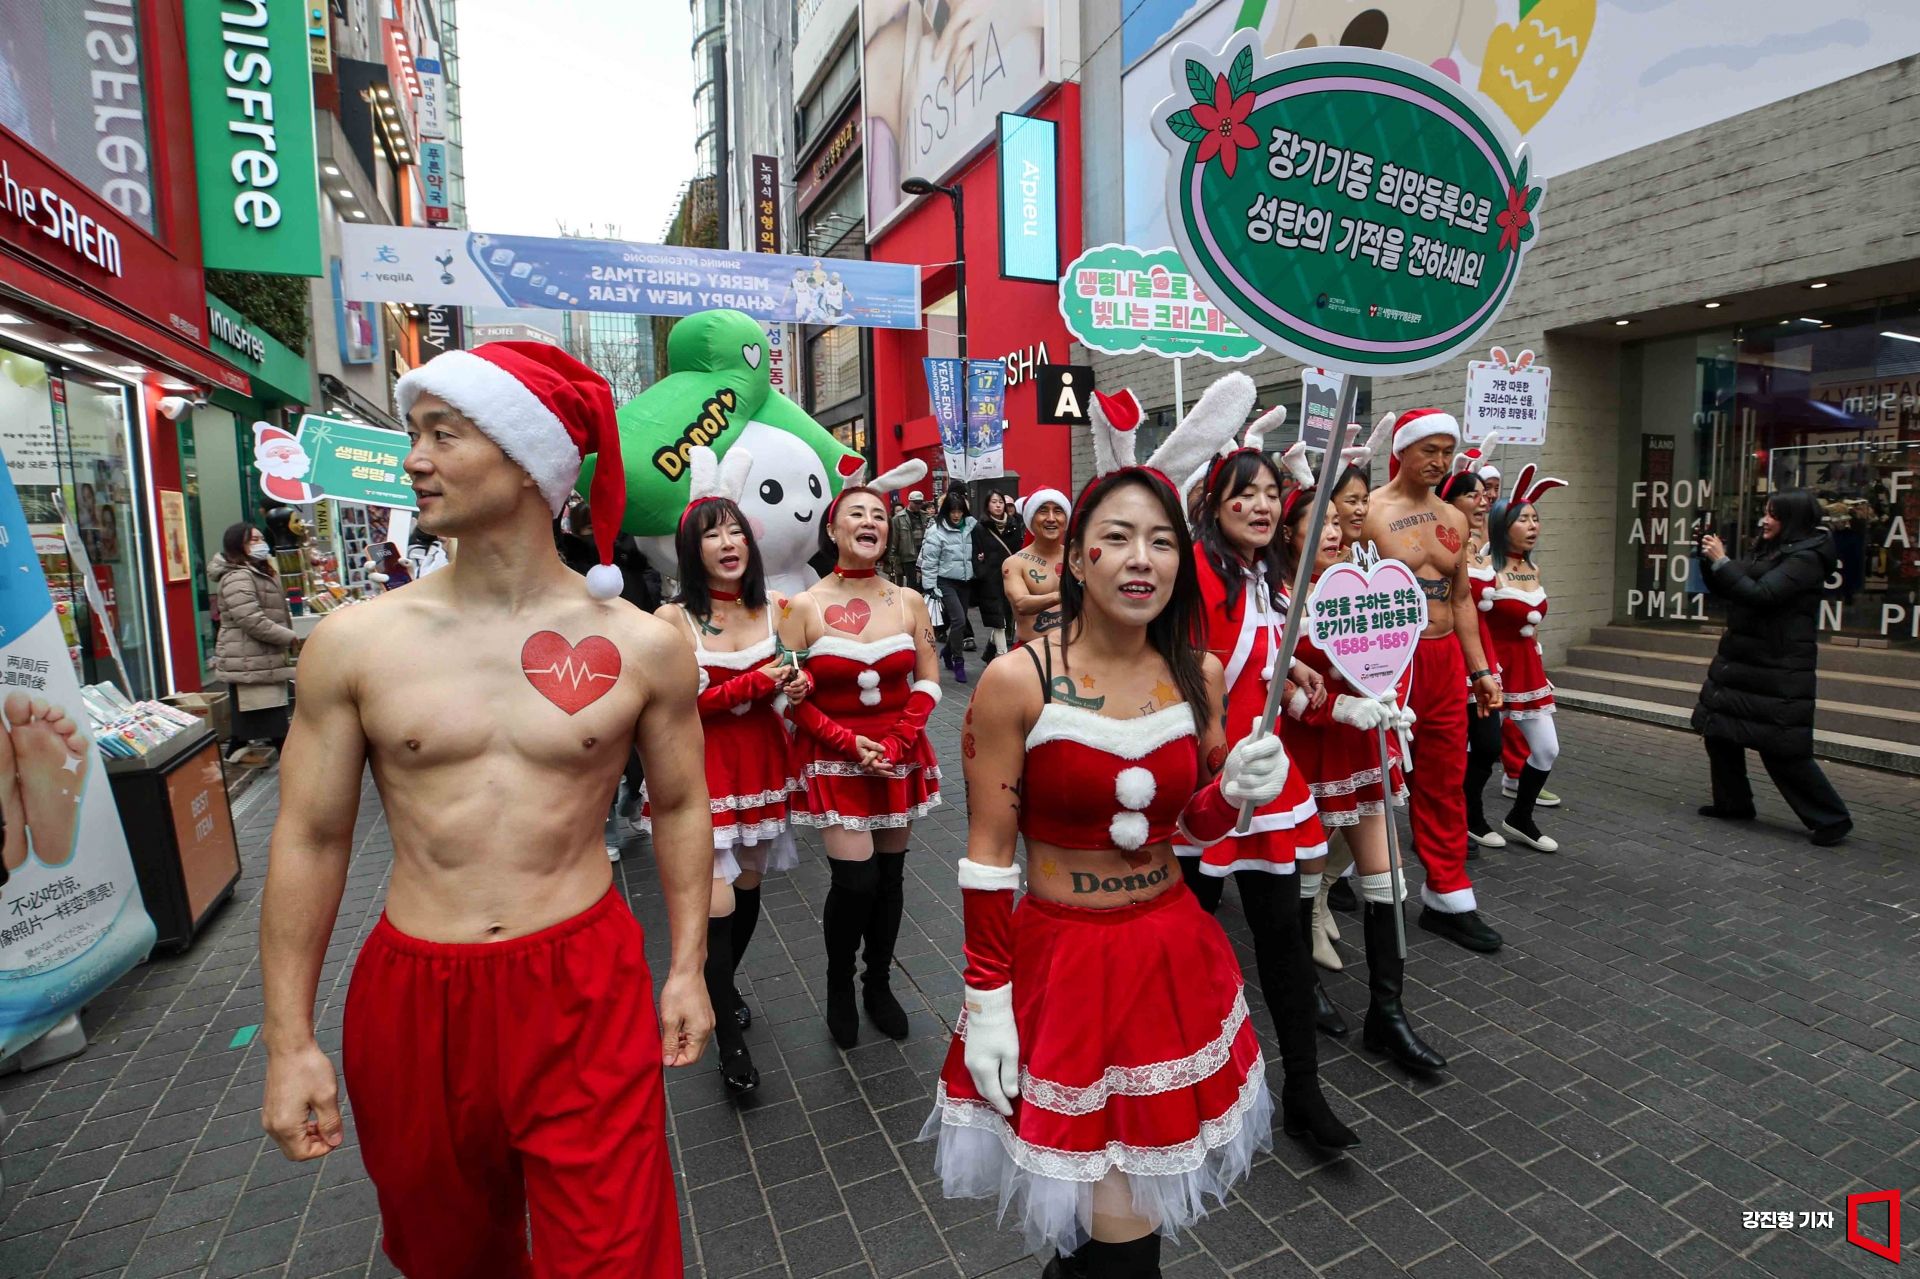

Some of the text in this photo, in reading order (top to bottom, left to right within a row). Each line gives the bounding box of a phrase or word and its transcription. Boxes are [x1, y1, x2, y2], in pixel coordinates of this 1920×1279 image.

[427, 147, 443, 204] 푸른약국
[1268, 128, 1492, 234] 장기기증 희망등록으로
[0, 160, 122, 278] he SAEM
[1247, 194, 1485, 288] 성탄의 기적을 전하세요!
[1078, 269, 1188, 299] 생명나눔으로
[1094, 302, 1149, 328] 빛나는
[487, 328, 513, 336] HOTEL
[937, 361, 953, 420] YEAR-END
[1483, 393, 1518, 405] 크리스마스
[1493, 380, 1529, 393] 가장 따뜻한
[978, 403, 995, 415] 30
[1478, 406, 1537, 420] 장기기증 희망등록!
[657, 402, 726, 477] Donor
[335, 445, 399, 467] 생명나눔
[1631, 479, 1712, 509] FROM
[317, 509, 328, 533] NAIL
[1506, 572, 1536, 582] Donor
[1648, 554, 1689, 583] TO
[1315, 588, 1421, 617] 9명을 구하는 약속,
[1627, 589, 1709, 621] PM11
[1316, 607, 1422, 640] 장기기증 희망등록!
[1333, 631, 1409, 656] 1588-1589
[191, 790, 209, 819] BEST
[196, 813, 214, 842] ITEM
[1070, 863, 1169, 894] Donor
